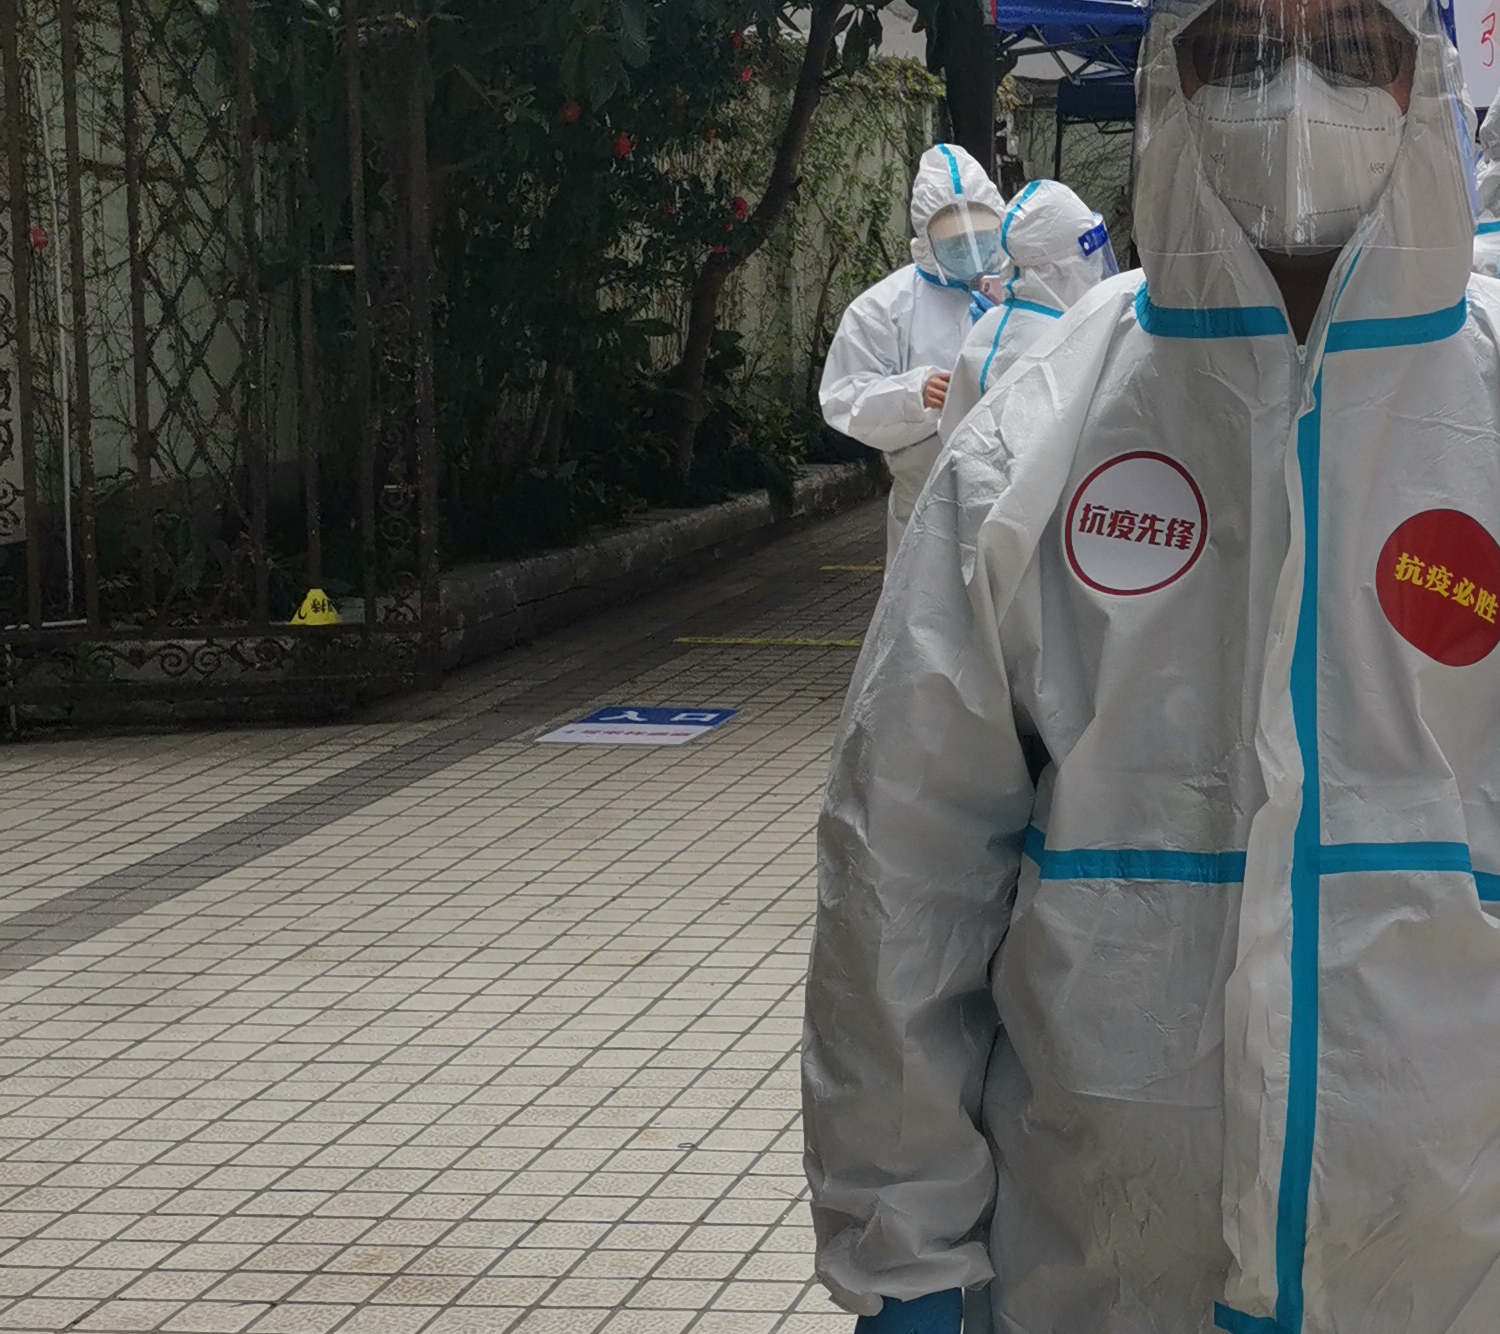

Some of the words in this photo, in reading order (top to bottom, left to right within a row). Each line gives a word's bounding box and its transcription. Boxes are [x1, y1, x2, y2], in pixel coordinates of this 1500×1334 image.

[1078, 503, 1195, 550] 抗疫先锋
[1394, 552, 1499, 624] 抗疫必胜
[600, 710, 722, 722] 入口
